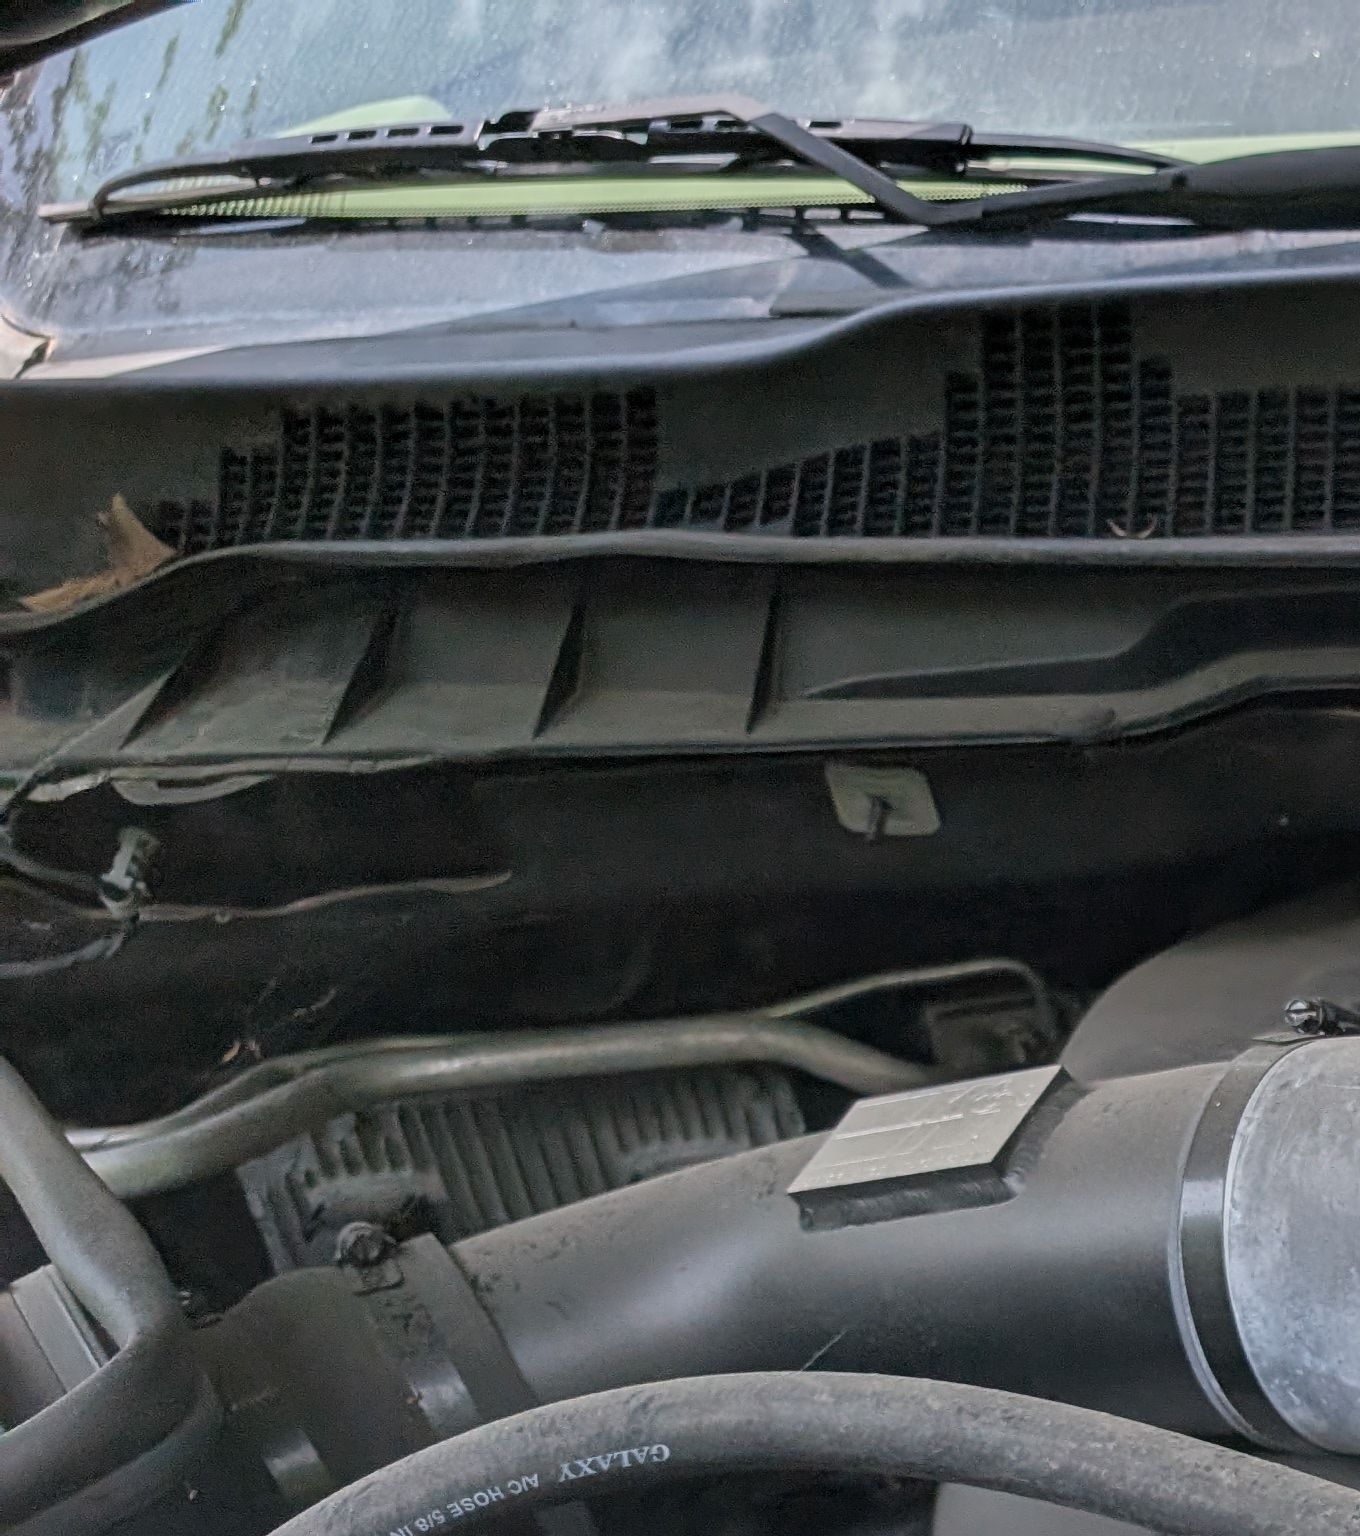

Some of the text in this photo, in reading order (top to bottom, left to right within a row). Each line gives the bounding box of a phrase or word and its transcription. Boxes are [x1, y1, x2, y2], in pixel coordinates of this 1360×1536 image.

[558, 1442, 671, 1484] GALAXY
[506, 1472, 541, 1500] A/C
[446, 1486, 505, 1520] HOSE
[415, 1507, 446, 1533] 5/8
